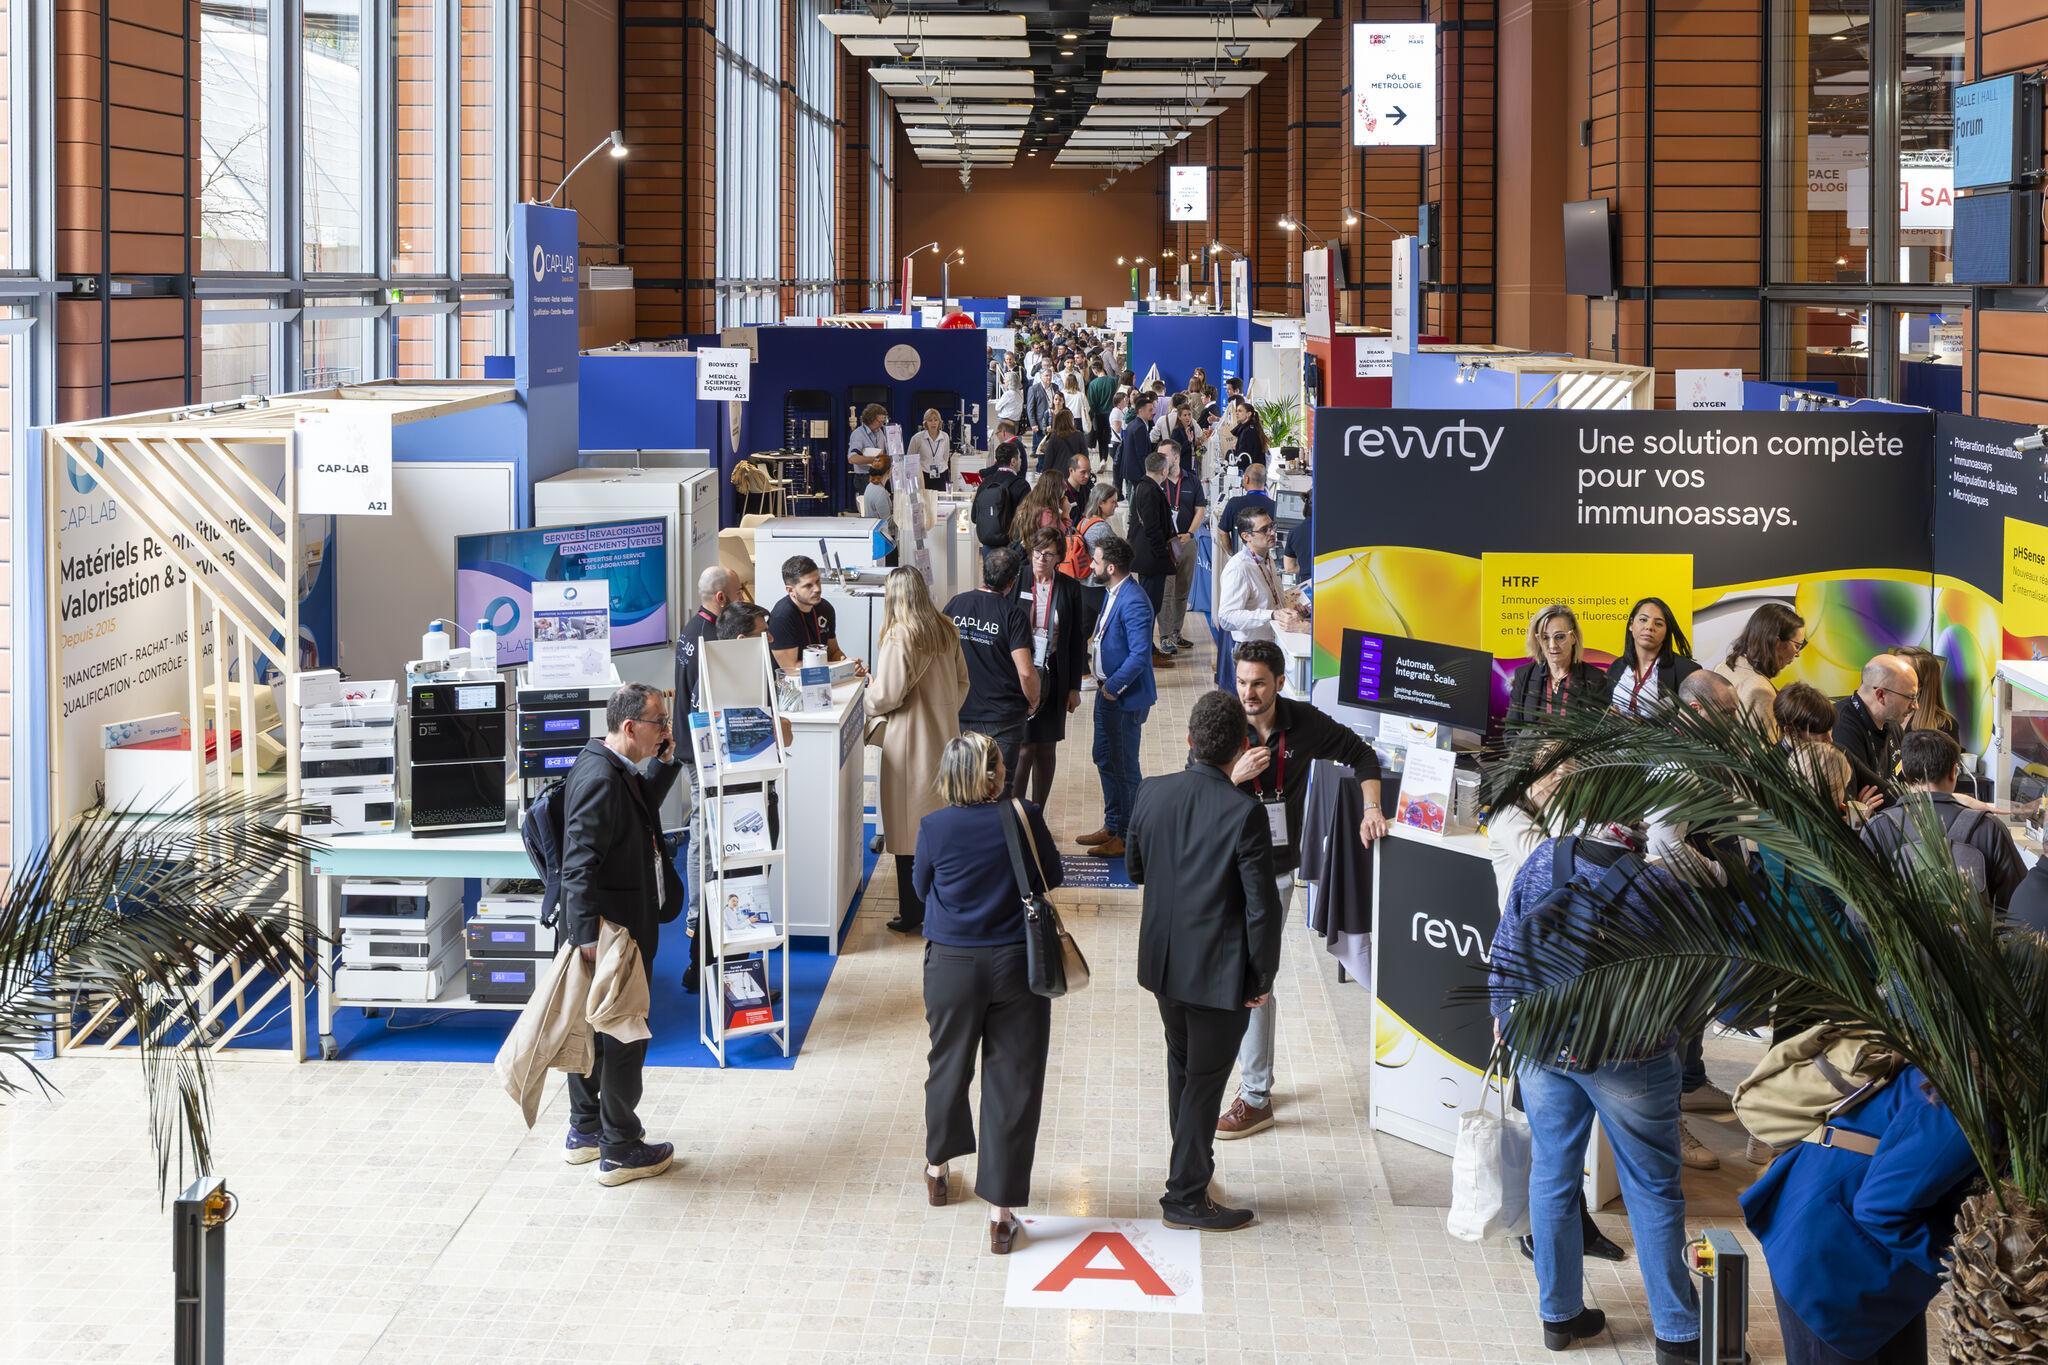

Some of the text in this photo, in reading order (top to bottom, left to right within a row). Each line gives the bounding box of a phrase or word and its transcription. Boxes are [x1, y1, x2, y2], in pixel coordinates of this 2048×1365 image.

[1956, 88, 1998, 108] SALLE HALL
[1956, 117, 1983, 138] Forum
[545, 253, 574, 273] CAP-LAB
[1344, 418, 1505, 472] revvity
[1578, 428, 1904, 463] Une solution complète
[1954, 437, 1985, 453] Préparation
[317, 464, 369, 474] CAP-LAB
[1953, 454, 1993, 473] Immunoassays
[1577, 467, 1706, 494] pour vos
[1953, 471, 2018, 496] Manipulation de liquides
[368, 501, 388, 511] A21
[1953, 488, 1989, 507] Microplaques
[1577, 499, 1798, 532] immunoassays.
[544, 525, 661, 543] SERVICES REVALORISATION
[562, 537, 662, 553] FINANCEMENTS VENTES
[60, 541, 139, 584] Matériels
[622, 552, 646, 560] SERVICE
[2013, 546, 2046, 566] pHSense
[1501, 575, 1540, 588] HTRF
[2012, 565, 2038, 582] Nouveaux
[60, 572, 160, 622] Valorisation
[164, 564, 175, 588] &
[1501, 594, 1629, 607] Immunoessais simples et
[952, 615, 999, 635] CAP-LAB
[1501, 611, 1525, 620] sans
[95, 618, 117, 637] 2015
[135, 638, 169, 661] RACHAT
[138, 656, 182, 684] CONTRÔLE
[1396, 656, 1436, 672] Automate.
[1395, 667, 1457, 686] Integrate. Scale.
[1393, 693, 1451, 709] Empowering momentum.
[1394, 686, 1436, 699] Igniting discovery.
[1411, 911, 1493, 964] revv
[1031, 1231, 1177, 1297] A
